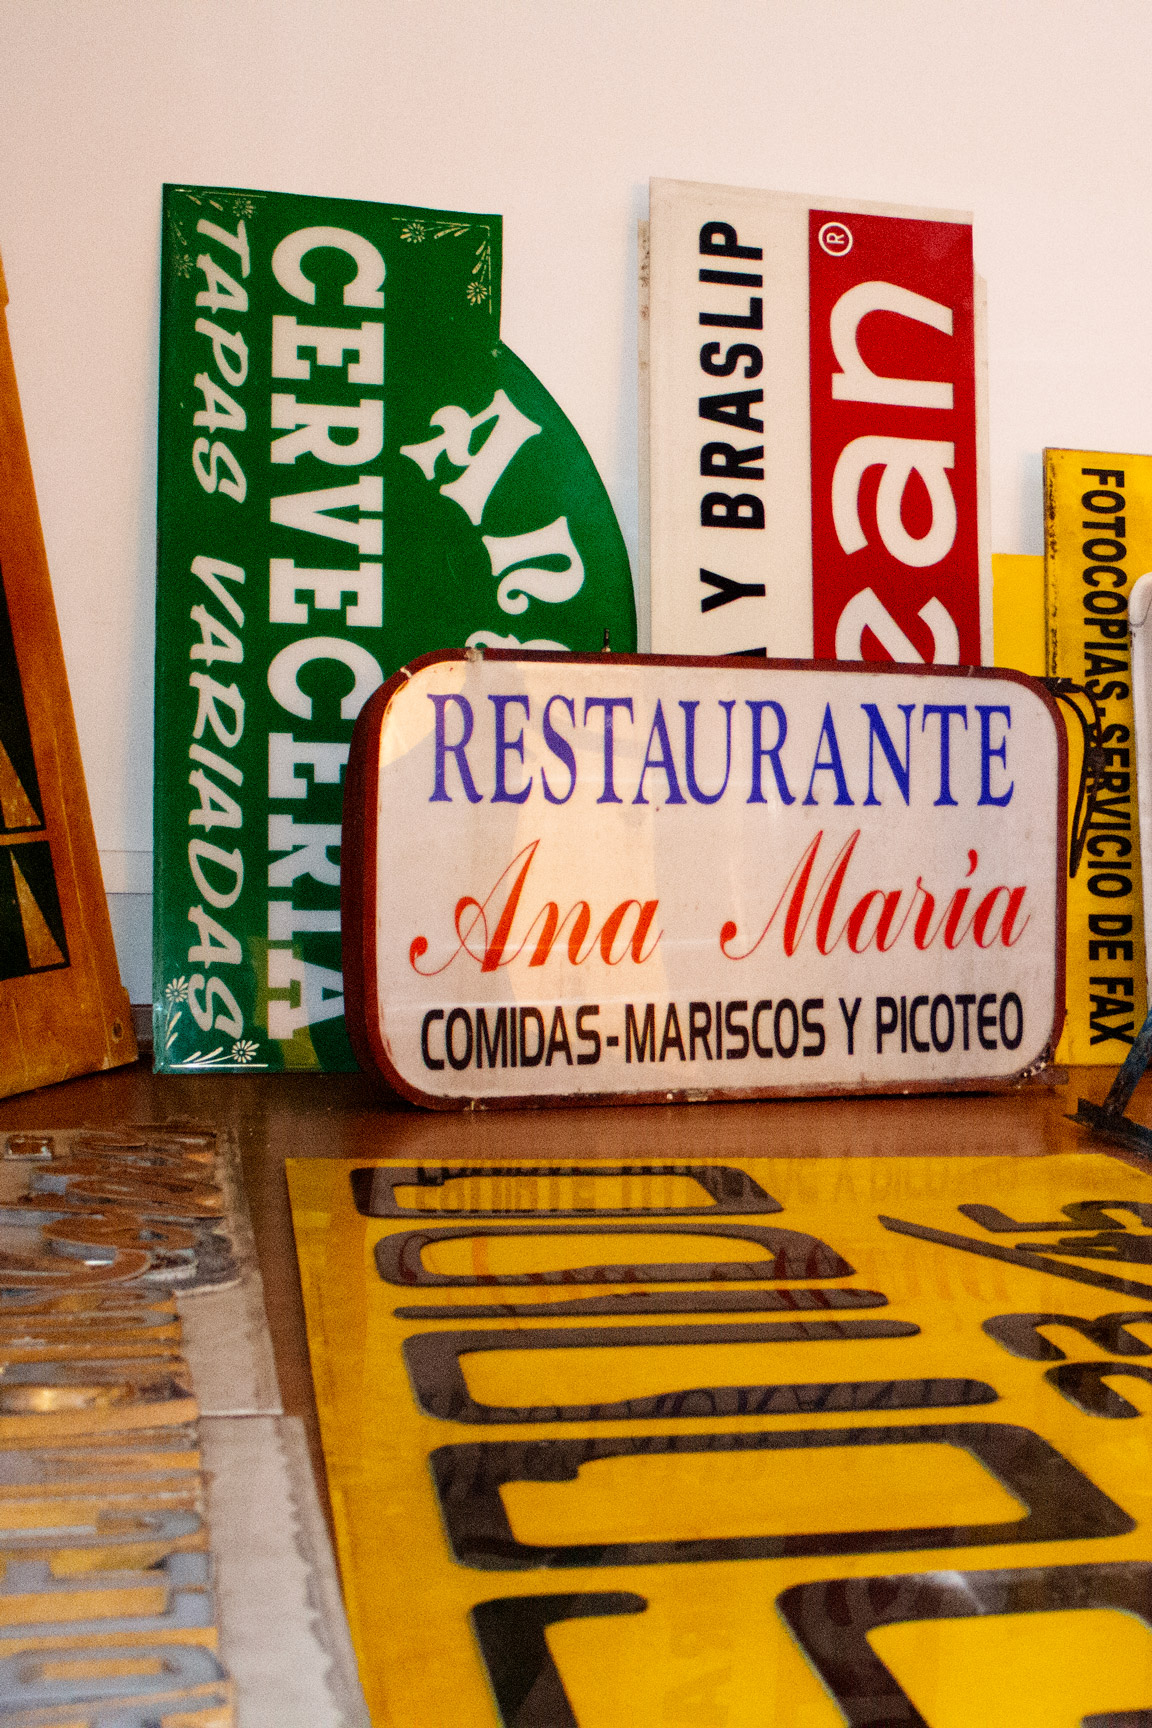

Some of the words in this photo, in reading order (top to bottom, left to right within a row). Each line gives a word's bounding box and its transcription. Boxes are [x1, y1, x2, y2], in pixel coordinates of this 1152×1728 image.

[191, 218, 251, 504] TAPAS
[699, 221, 766, 530] BRASLIP
[268, 226, 387, 1040] CERVECERIA
[701, 568, 767, 614] Y
[188, 555, 246, 1041] VARIADAS
[427, 693, 1014, 808] RESTAURANTE
[409, 839, 664, 977] Ana
[1088, 914, 1134, 962] DE
[838, 997, 863, 1056] Y
[875, 991, 1025, 1054] PICOTEO
[1089, 976, 1135, 1046] FAX
